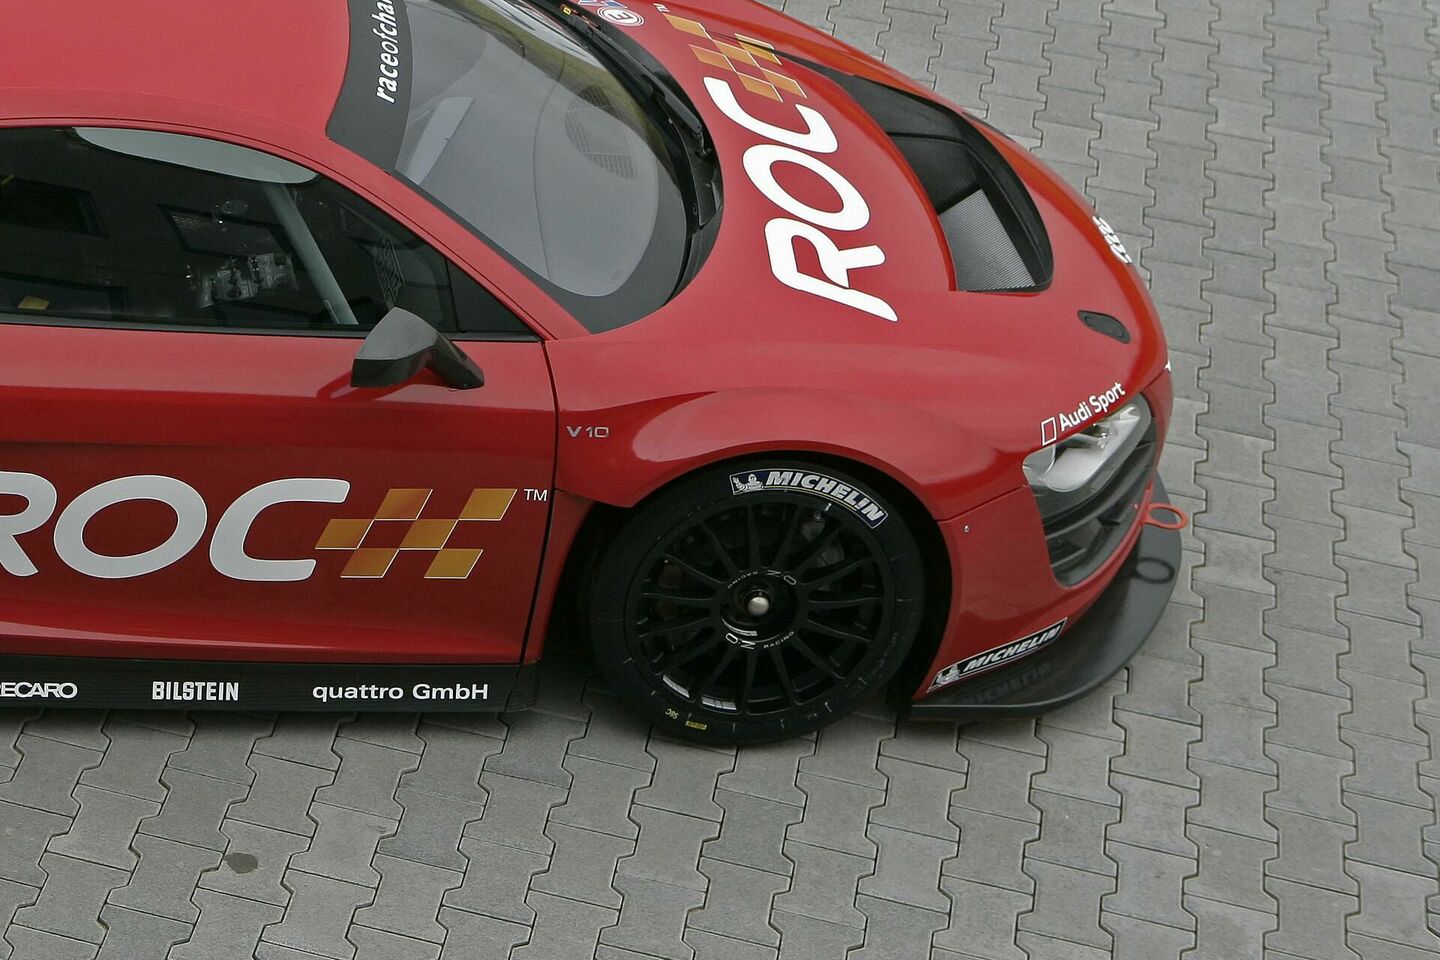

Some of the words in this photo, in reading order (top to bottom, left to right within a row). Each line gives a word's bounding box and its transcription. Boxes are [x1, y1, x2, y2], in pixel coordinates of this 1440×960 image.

[703, 76, 899, 323] ROC
[1059, 401, 1093, 432] Audi
[1088, 382, 1126, 413] Sport
[523, 488, 548, 502] TM
[765, 471, 885, 522] MICHELIN
[963, 625, 1060, 672] MICHELIN
[152, 681, 239, 701] BILSTEIN
[312, 684, 404, 702] quattro
[412, 683, 488, 700] GmbH
